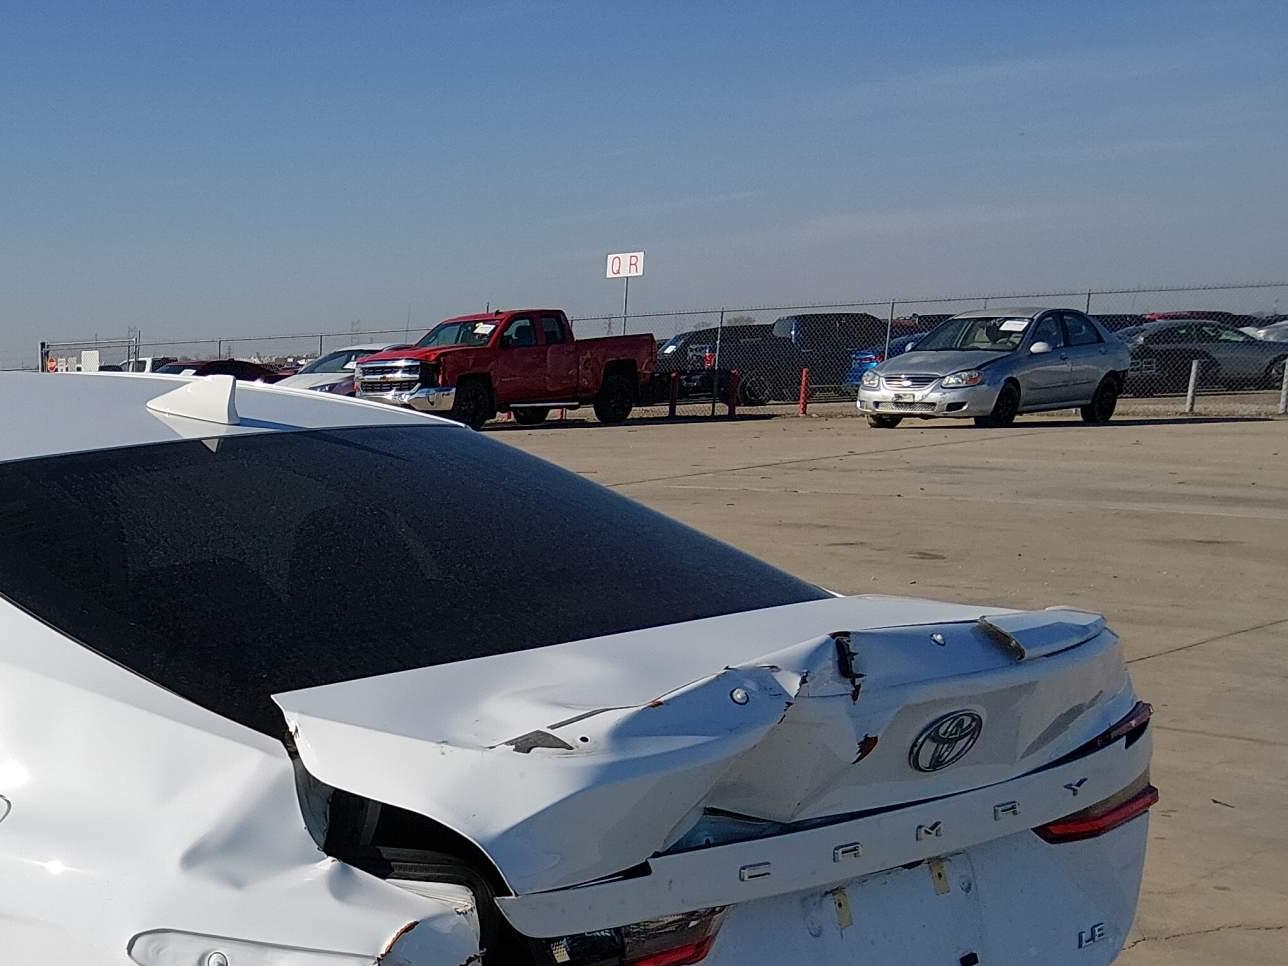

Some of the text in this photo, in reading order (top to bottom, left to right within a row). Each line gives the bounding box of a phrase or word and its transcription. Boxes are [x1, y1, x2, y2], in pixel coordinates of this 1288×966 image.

[612, 255, 639, 275] Q R
[738, 776, 1088, 882] CAMRY
[1078, 922, 1104, 949] LE
